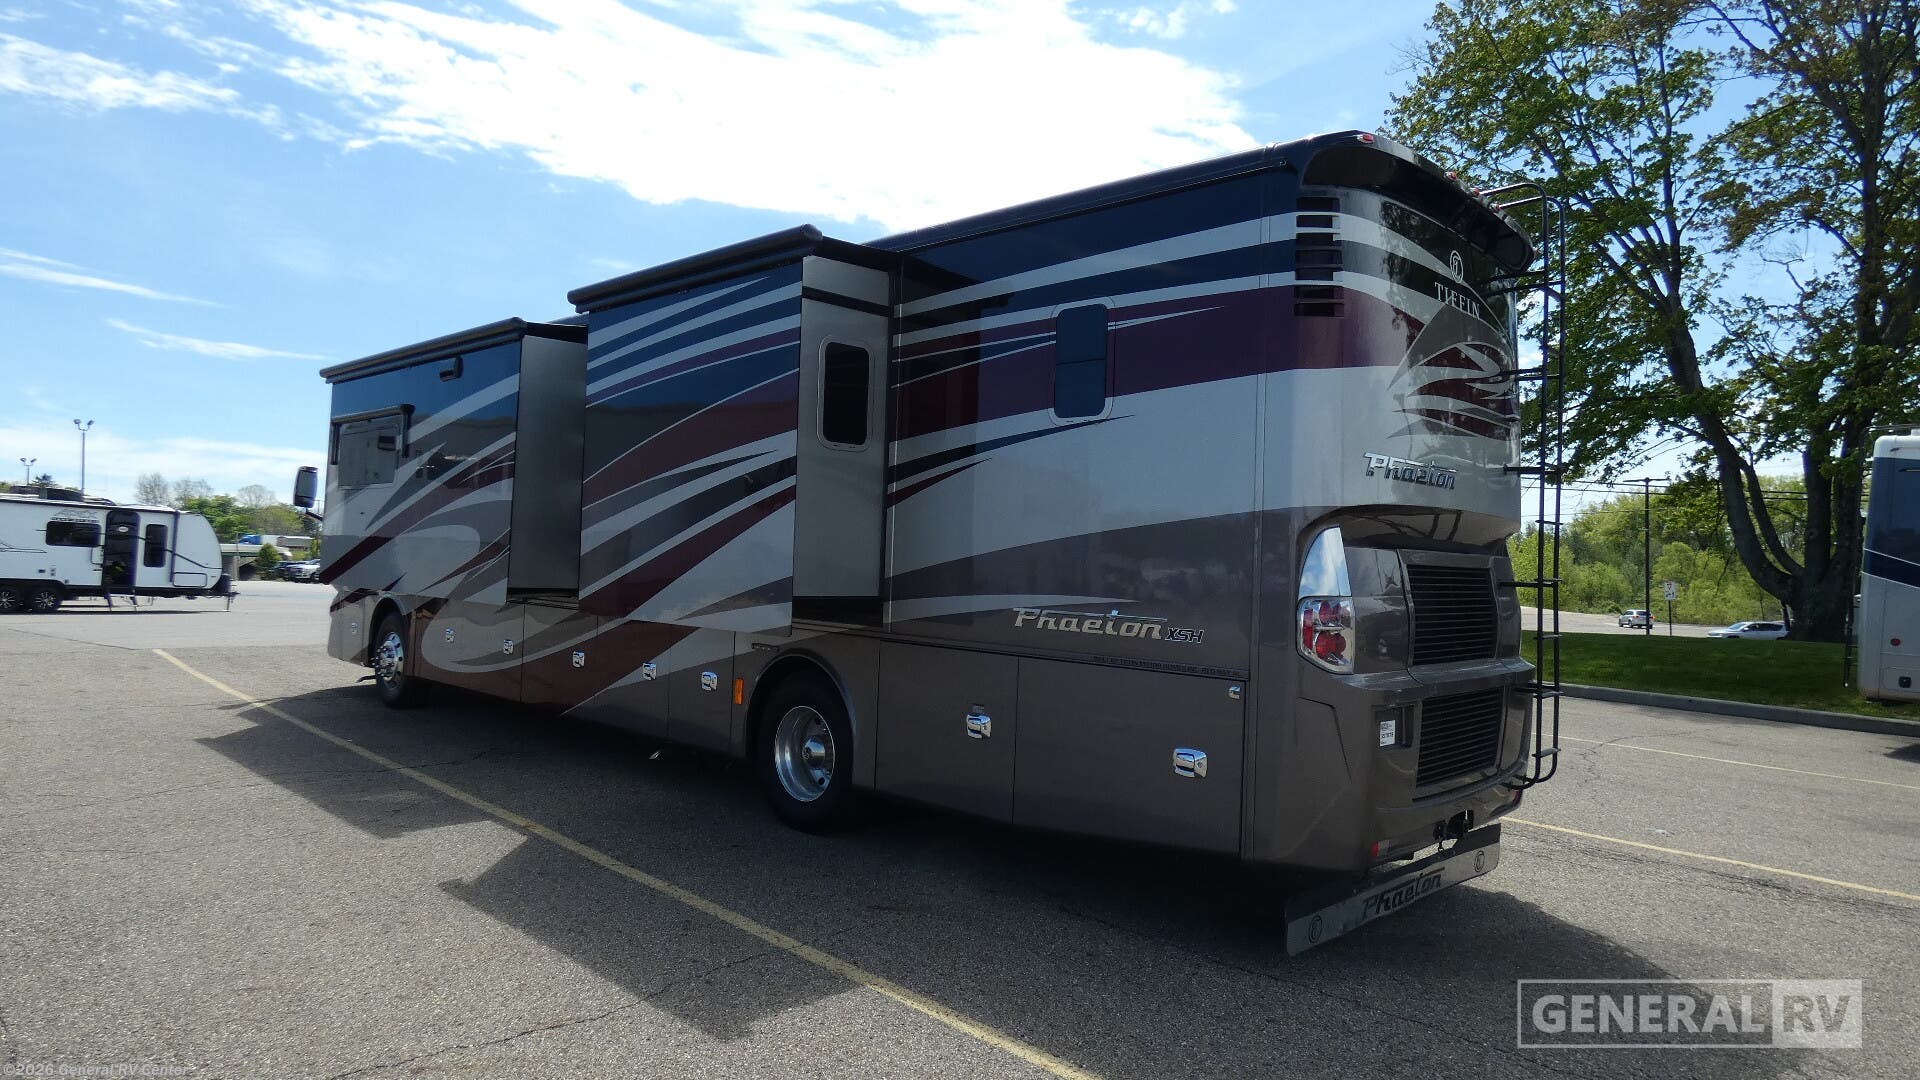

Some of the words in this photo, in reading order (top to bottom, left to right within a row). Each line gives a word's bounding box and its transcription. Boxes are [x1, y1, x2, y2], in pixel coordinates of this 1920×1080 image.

[1435, 282, 1480, 320] TIFFIN
[1364, 452, 1457, 490] Phaeton
[1012, 607, 1168, 640] Phaeton
[1165, 626, 1205, 644] XSH
[1363, 866, 1446, 921] Phaeton
